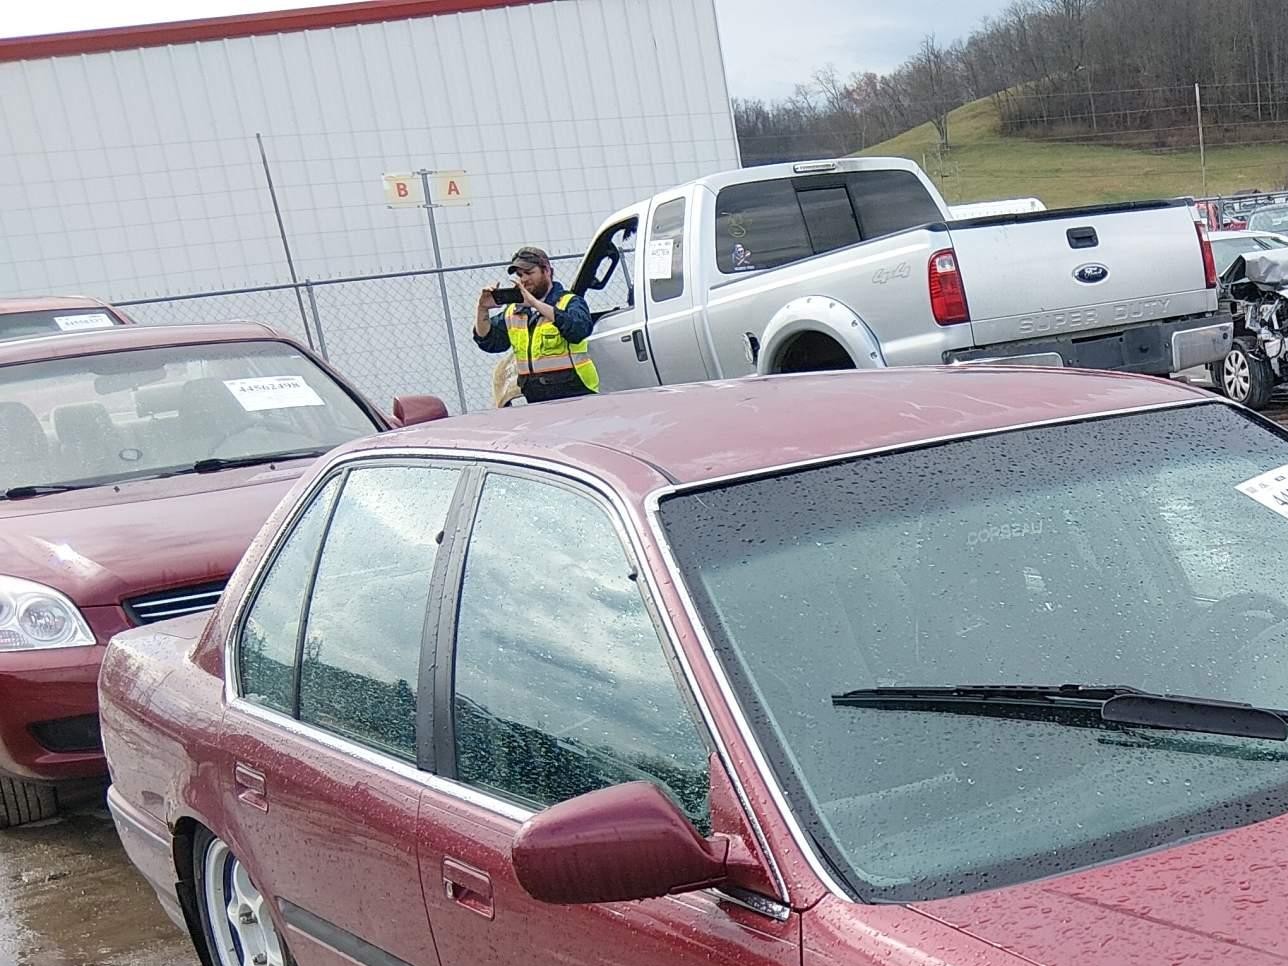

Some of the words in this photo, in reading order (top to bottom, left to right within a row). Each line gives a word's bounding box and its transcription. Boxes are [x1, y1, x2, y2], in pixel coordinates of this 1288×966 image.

[395, 182, 409, 198] B
[447, 180, 460, 196] A
[1019, 307, 1099, 334] SUPER
[1114, 299, 1171, 321] DUTY
[967, 520, 1042, 545] CORBEAU
